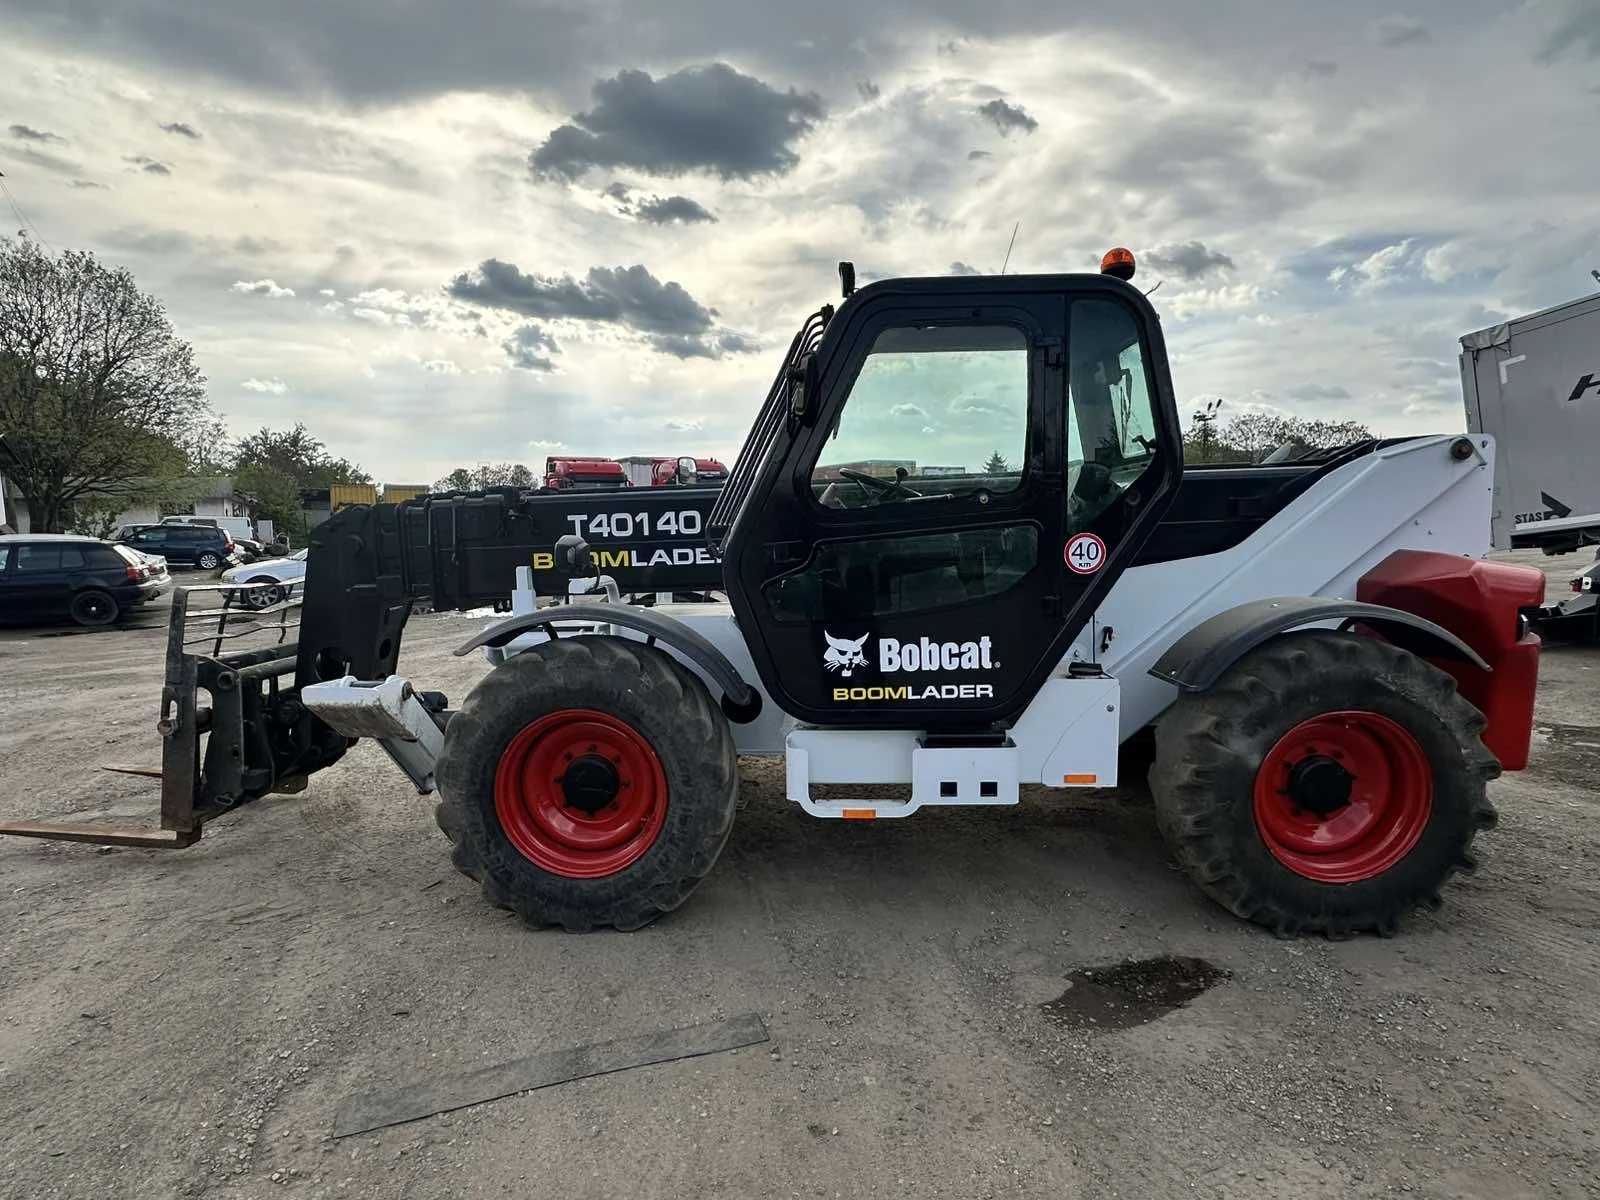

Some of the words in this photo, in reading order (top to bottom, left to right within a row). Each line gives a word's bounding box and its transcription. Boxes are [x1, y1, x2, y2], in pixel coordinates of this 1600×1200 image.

[567, 510, 702, 538] T40140
[1514, 511, 1543, 524] STAS
[1071, 541, 1100, 561] 40
[879, 635, 993, 673] Bobcat
[833, 684, 994, 701] BOOMLADER
